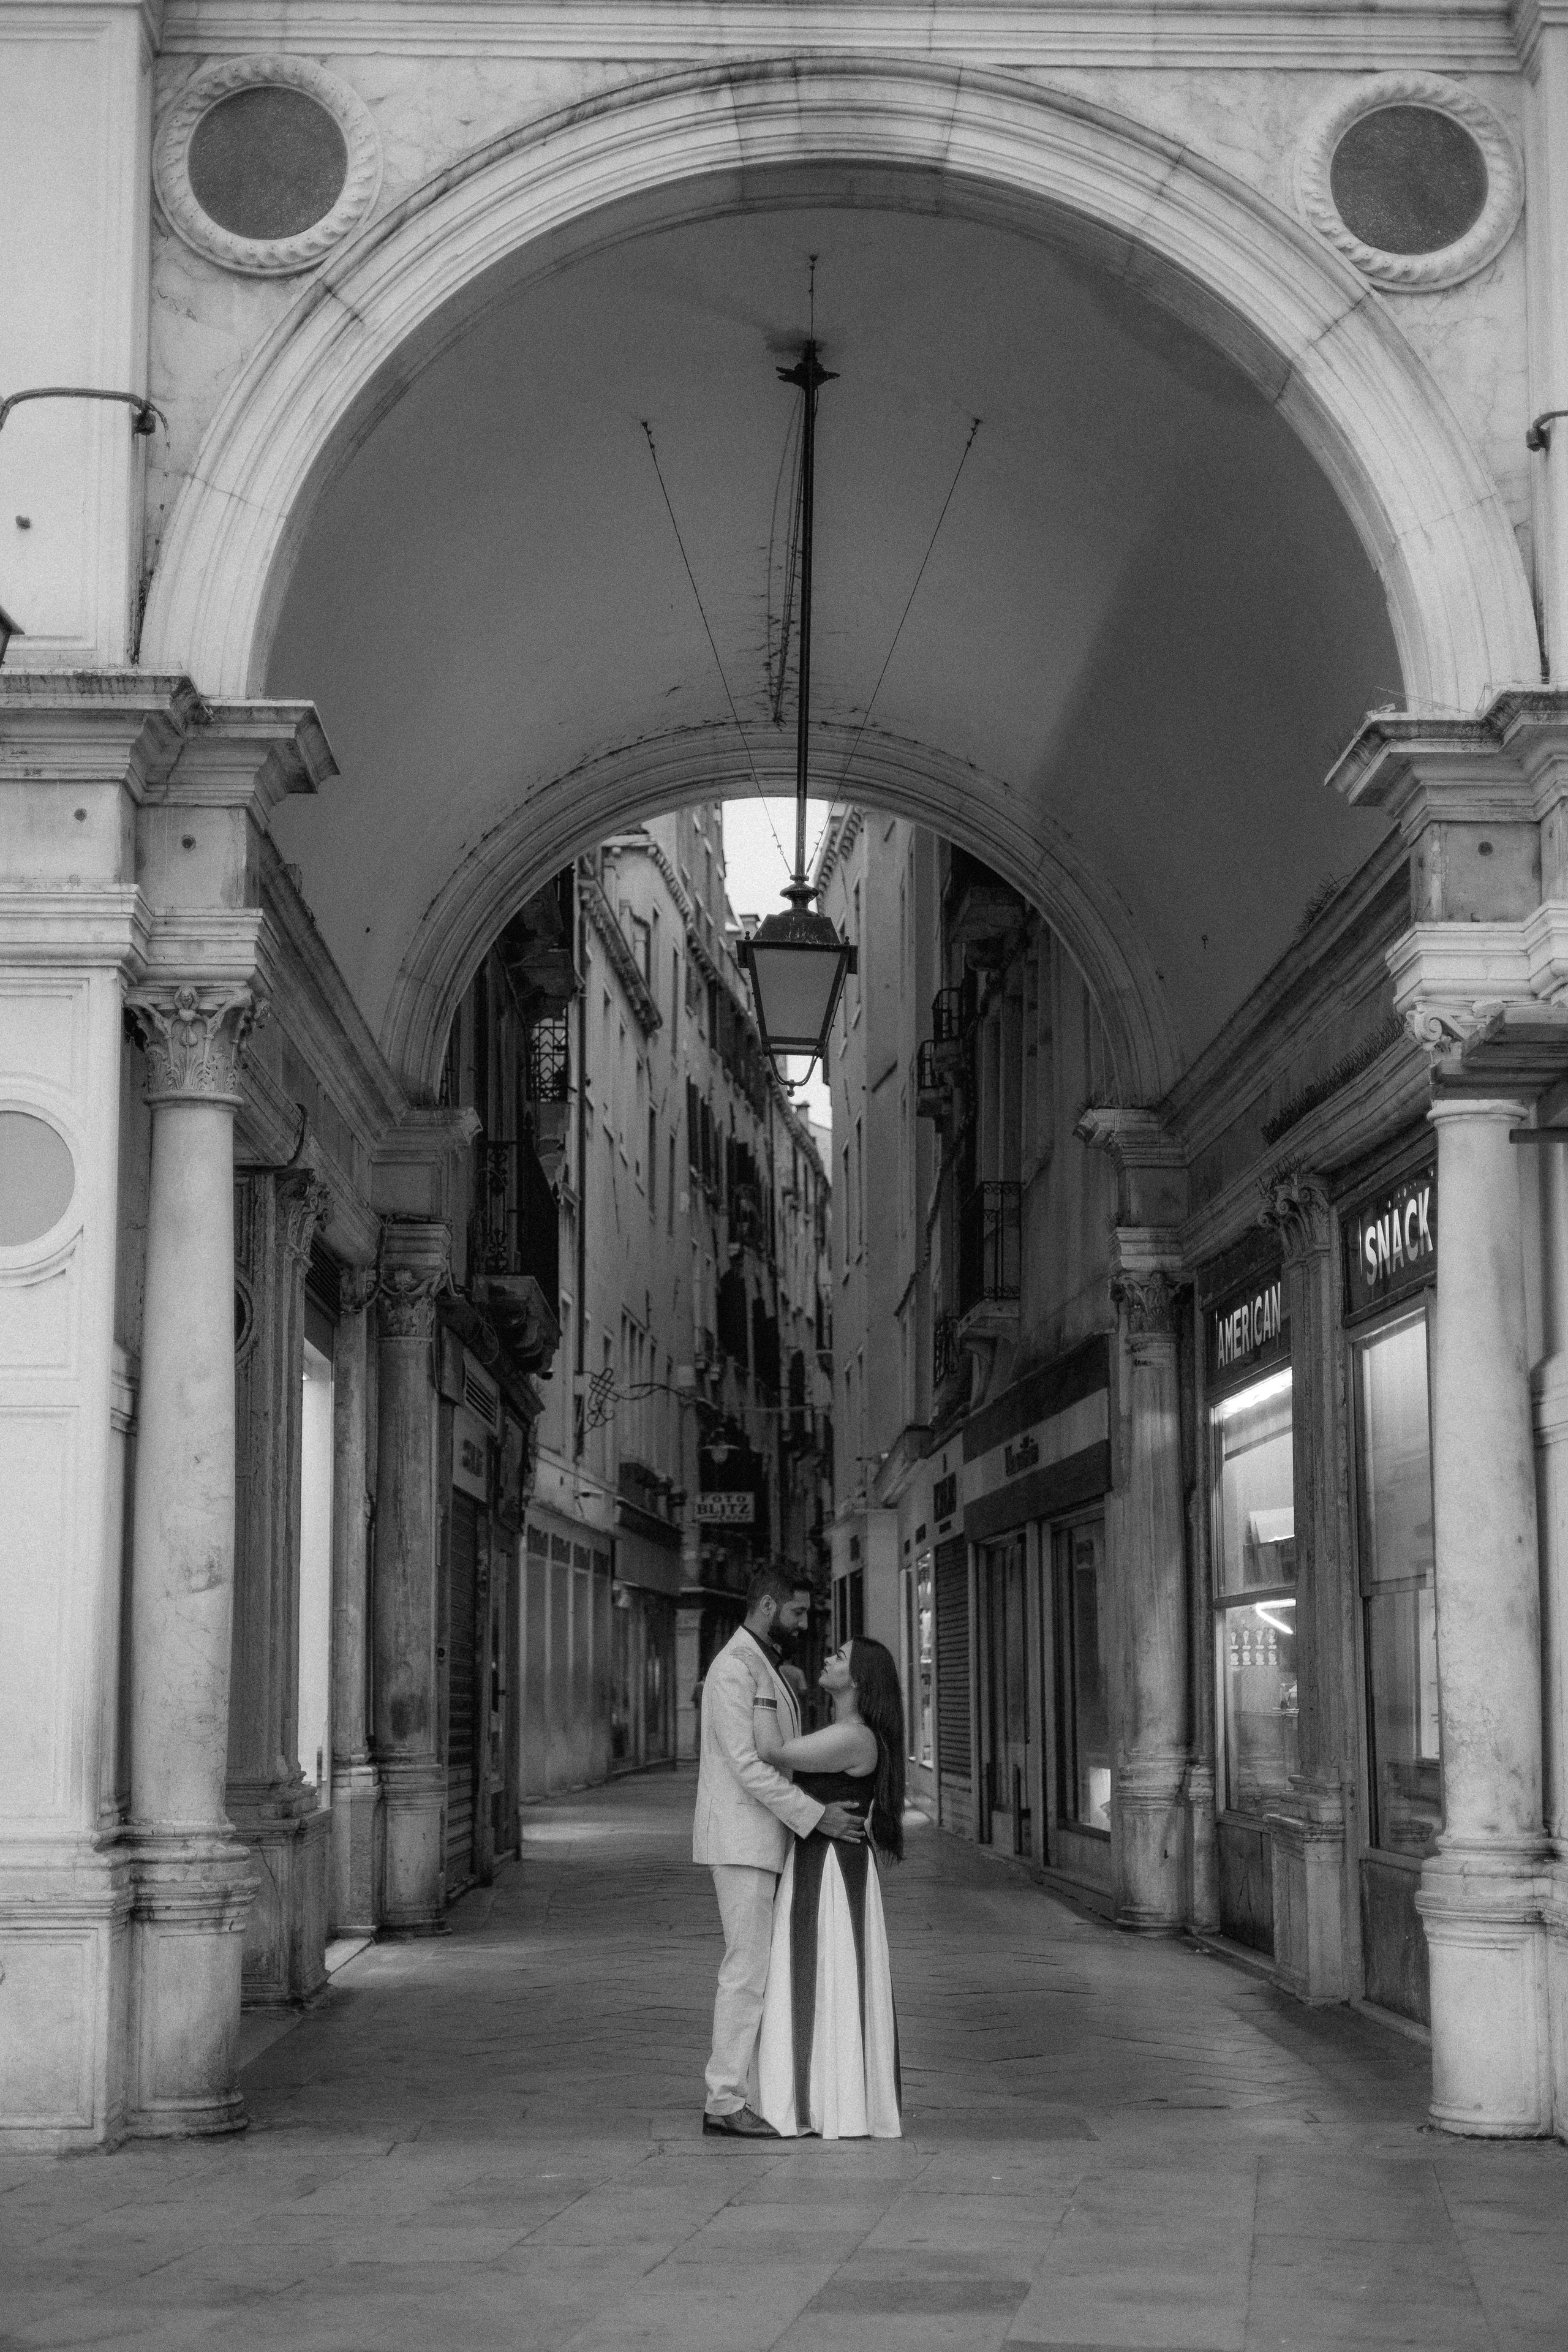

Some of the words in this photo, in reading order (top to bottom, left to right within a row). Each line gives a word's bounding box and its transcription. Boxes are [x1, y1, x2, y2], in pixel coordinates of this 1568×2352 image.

[1365, 1186, 1433, 1286] SNACK
[1218, 1281, 1281, 1369] AMERICAN
[697, 1503, 750, 1515] BLITZ
